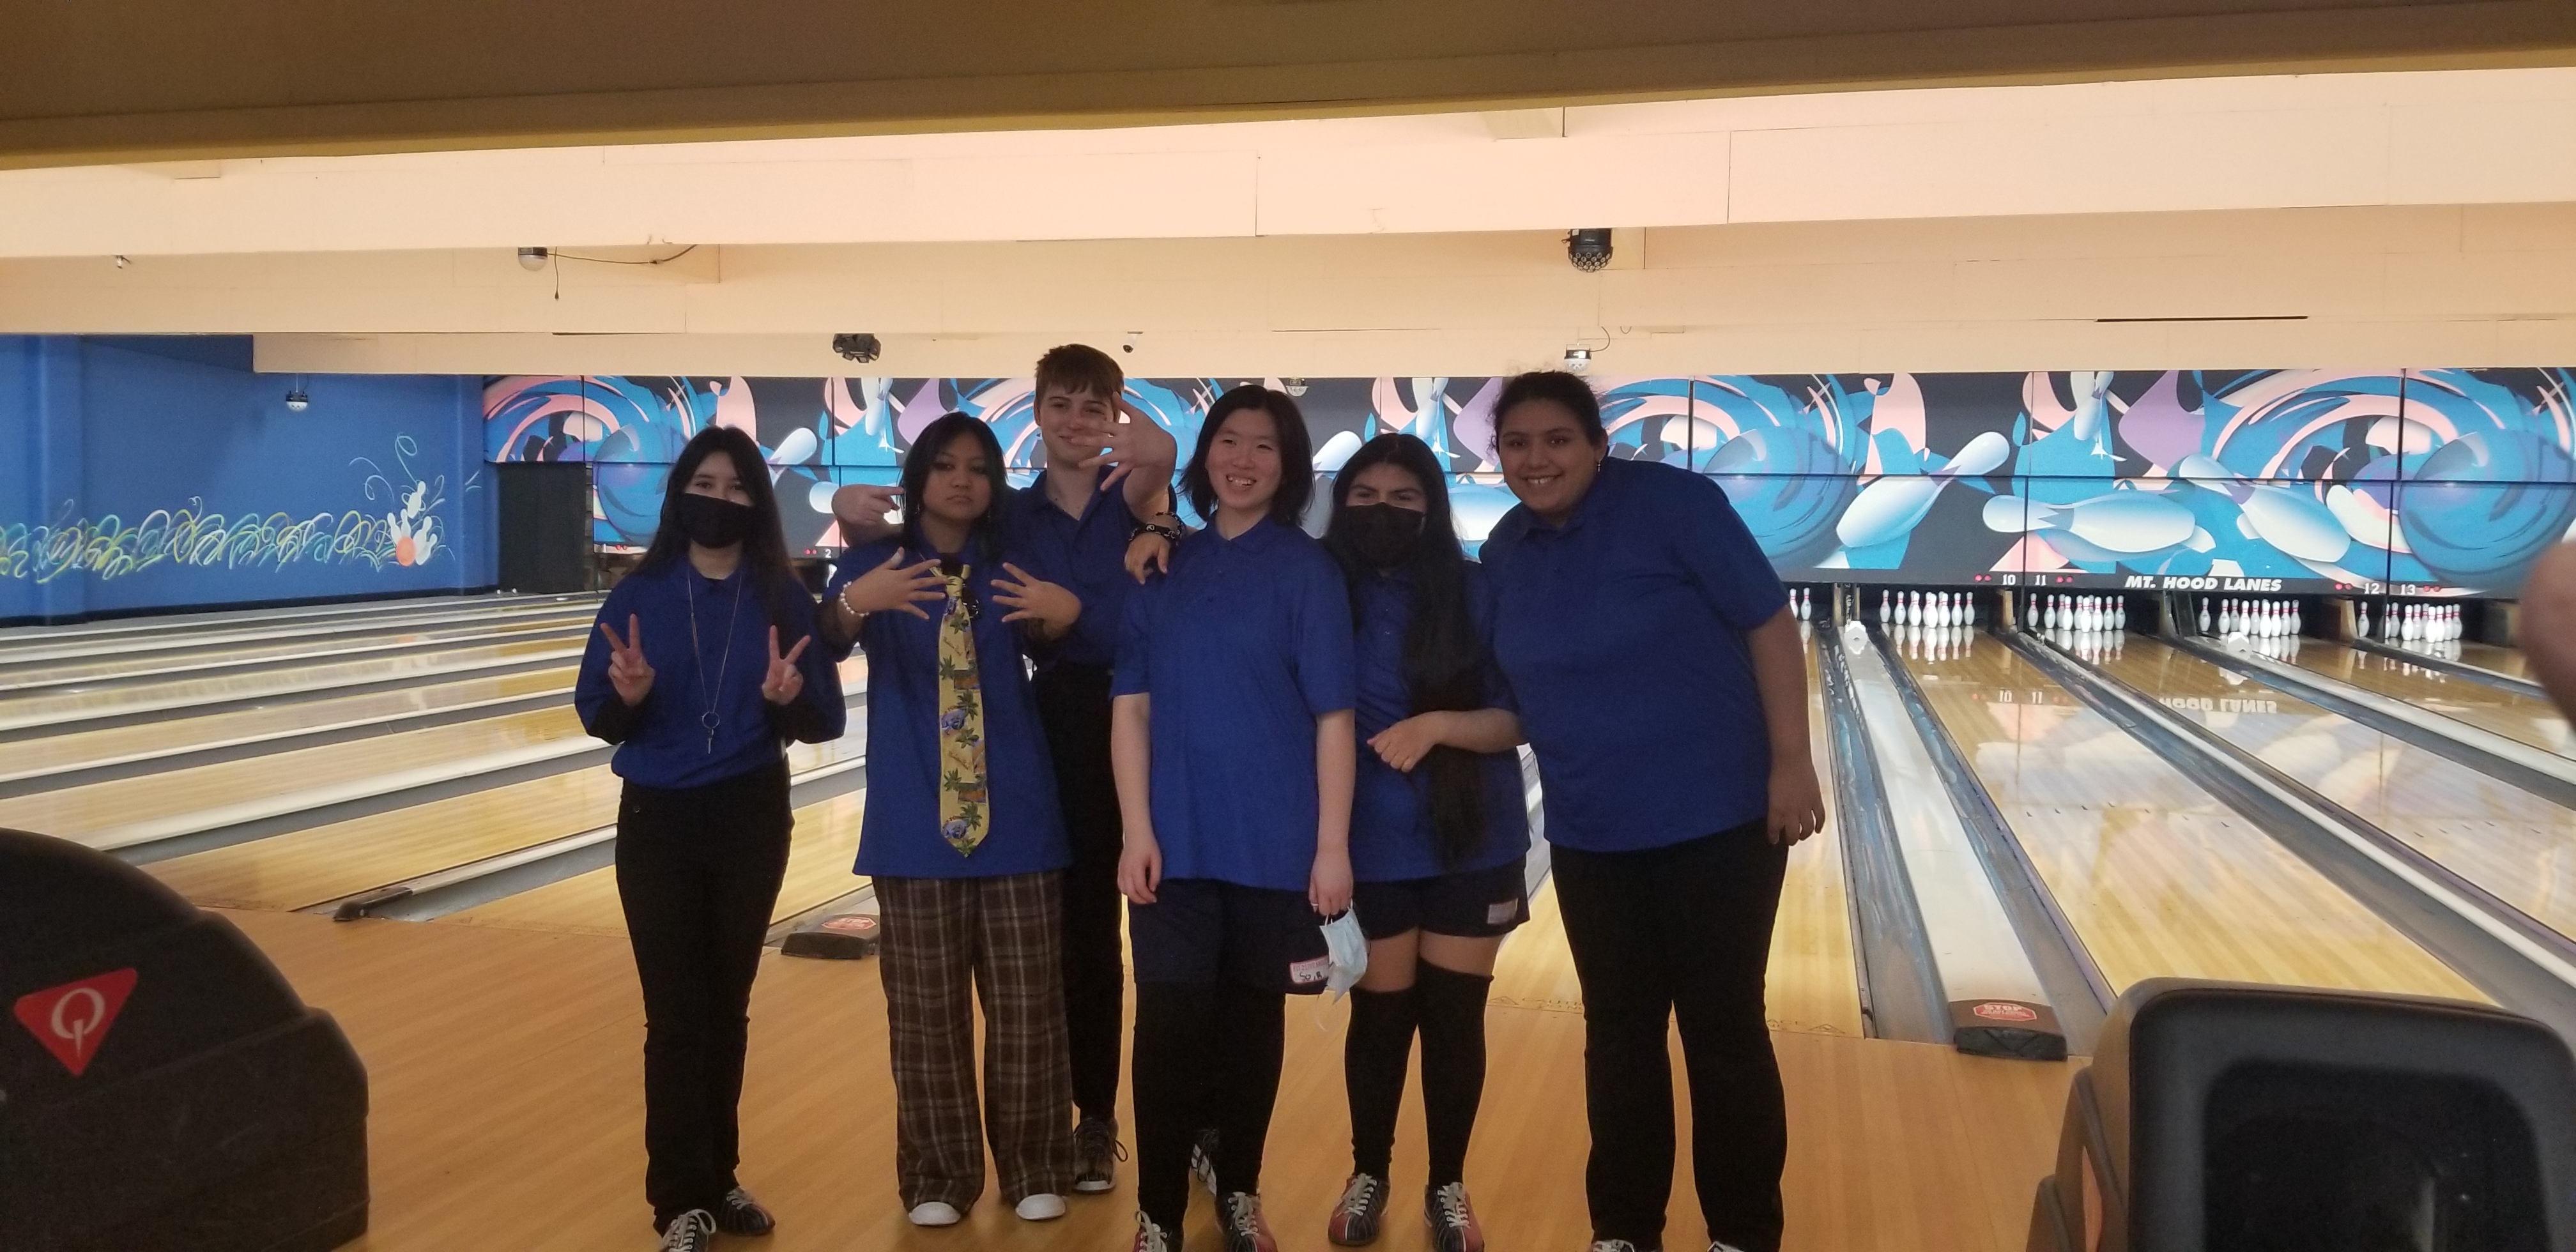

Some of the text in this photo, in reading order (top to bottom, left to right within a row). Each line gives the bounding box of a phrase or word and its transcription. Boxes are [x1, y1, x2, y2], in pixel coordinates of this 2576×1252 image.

[824, 548, 832, 559] 2
[2002, 574, 2016, 586] 10
[2034, 574, 2047, 586] 11
[2124, 575, 2283, 592] MT. HOOD LANES
[2364, 582, 2380, 595] 12
[2400, 584, 2416, 596] 13
[52, 988, 105, 1057] Q
